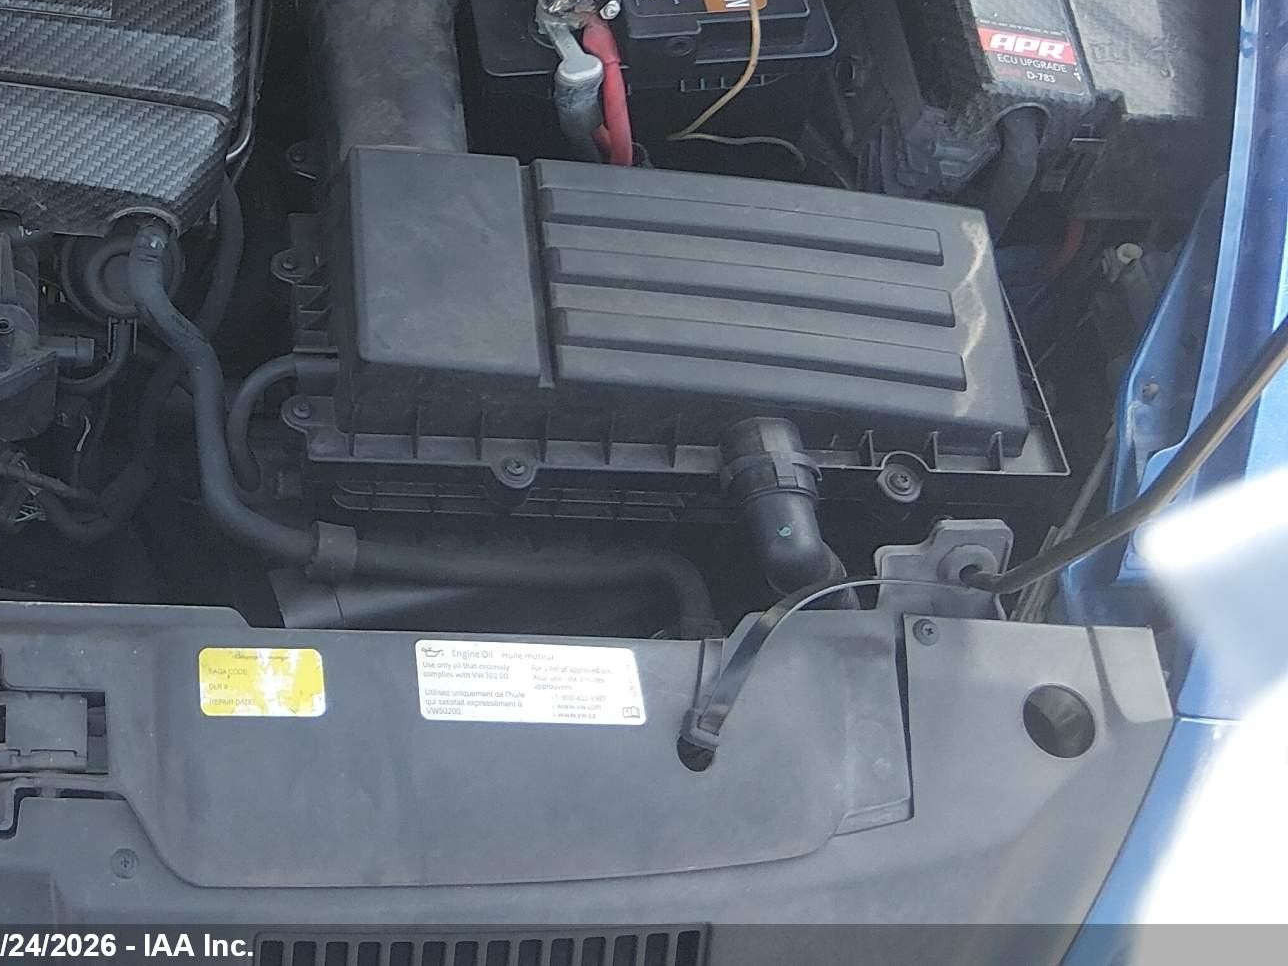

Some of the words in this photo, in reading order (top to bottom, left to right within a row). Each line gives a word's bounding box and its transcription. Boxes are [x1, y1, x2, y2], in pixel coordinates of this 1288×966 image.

[990, 34, 1065, 60] APR
[996, 54, 1018, 65] ECU
[1019, 58, 1068, 73] UPGRADE
[1026, 71, 1056, 83] D-783
[451, 649, 480, 659] Engine
[481, 650, 493, 658] Oil
